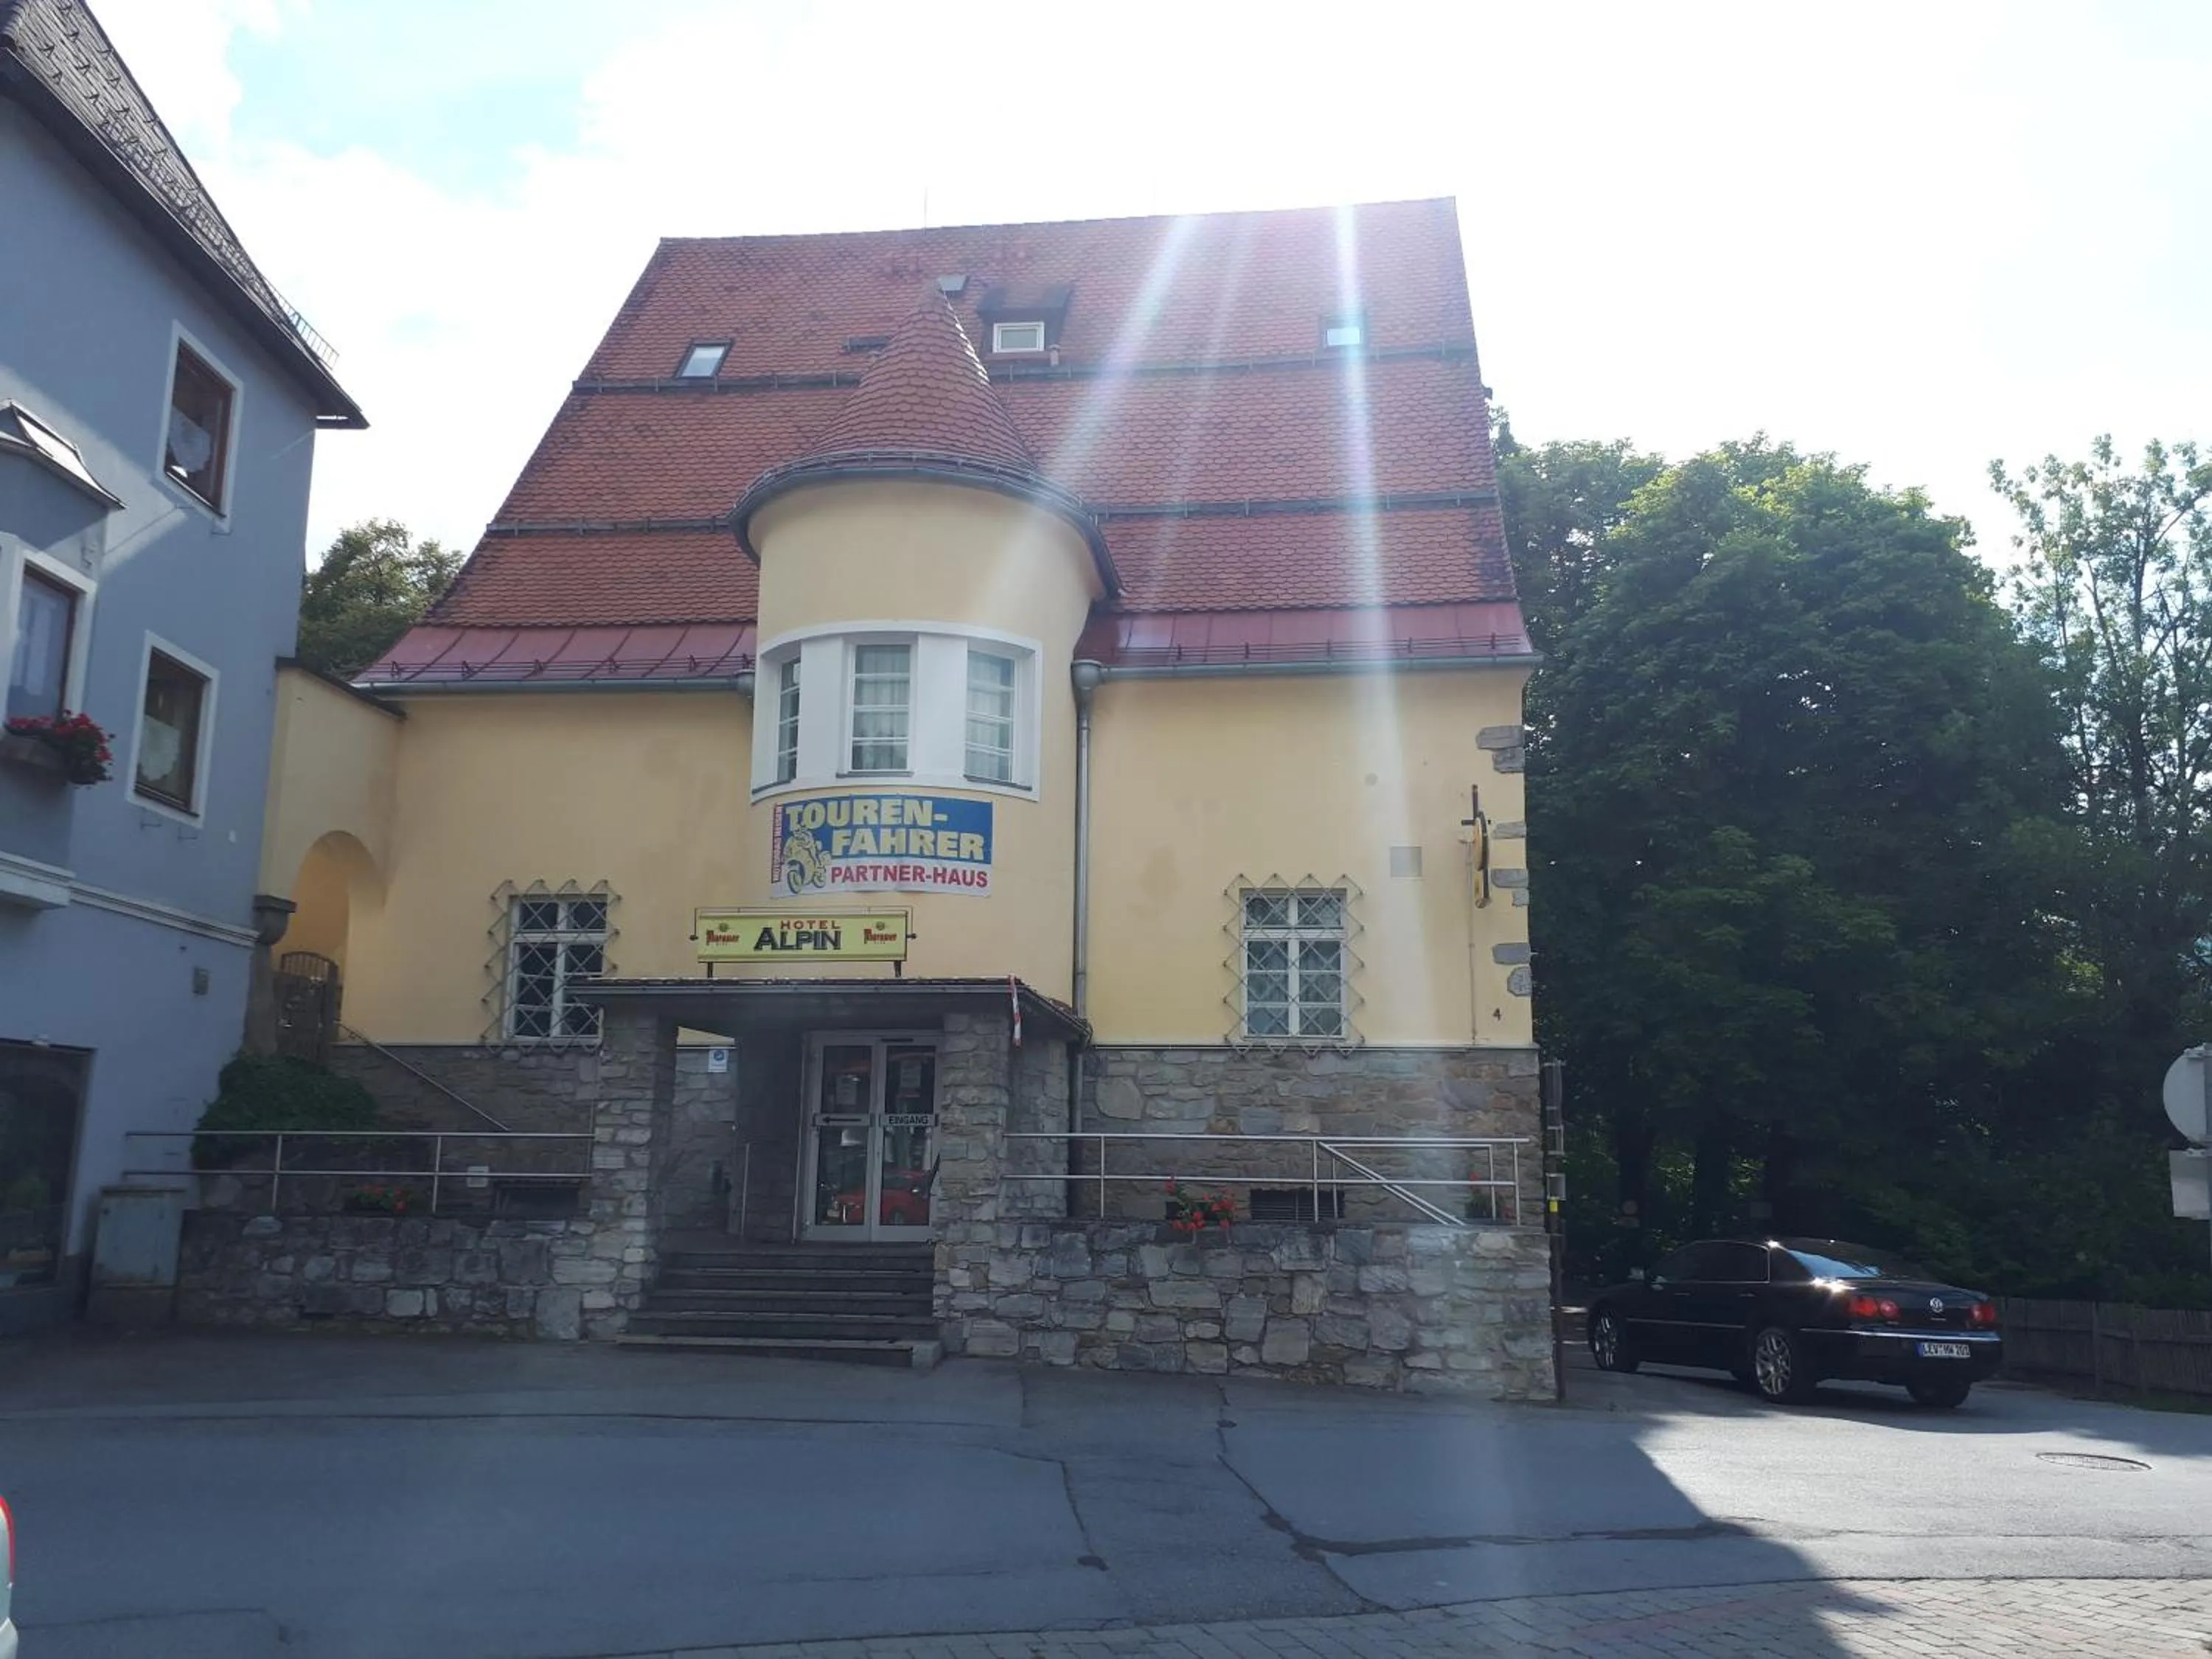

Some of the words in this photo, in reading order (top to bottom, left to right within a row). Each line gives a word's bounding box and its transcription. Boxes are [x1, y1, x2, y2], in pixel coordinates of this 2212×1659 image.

[786, 799, 948, 830] TOUREN-
[831, 827, 985, 860] FAHRER
[830, 864, 989, 888] PARTNER-HAUS
[780, 919, 841, 931] HOTEL
[1492, 1007, 1503, 1021] 4
[888, 1115, 929, 1125] EINGANG
